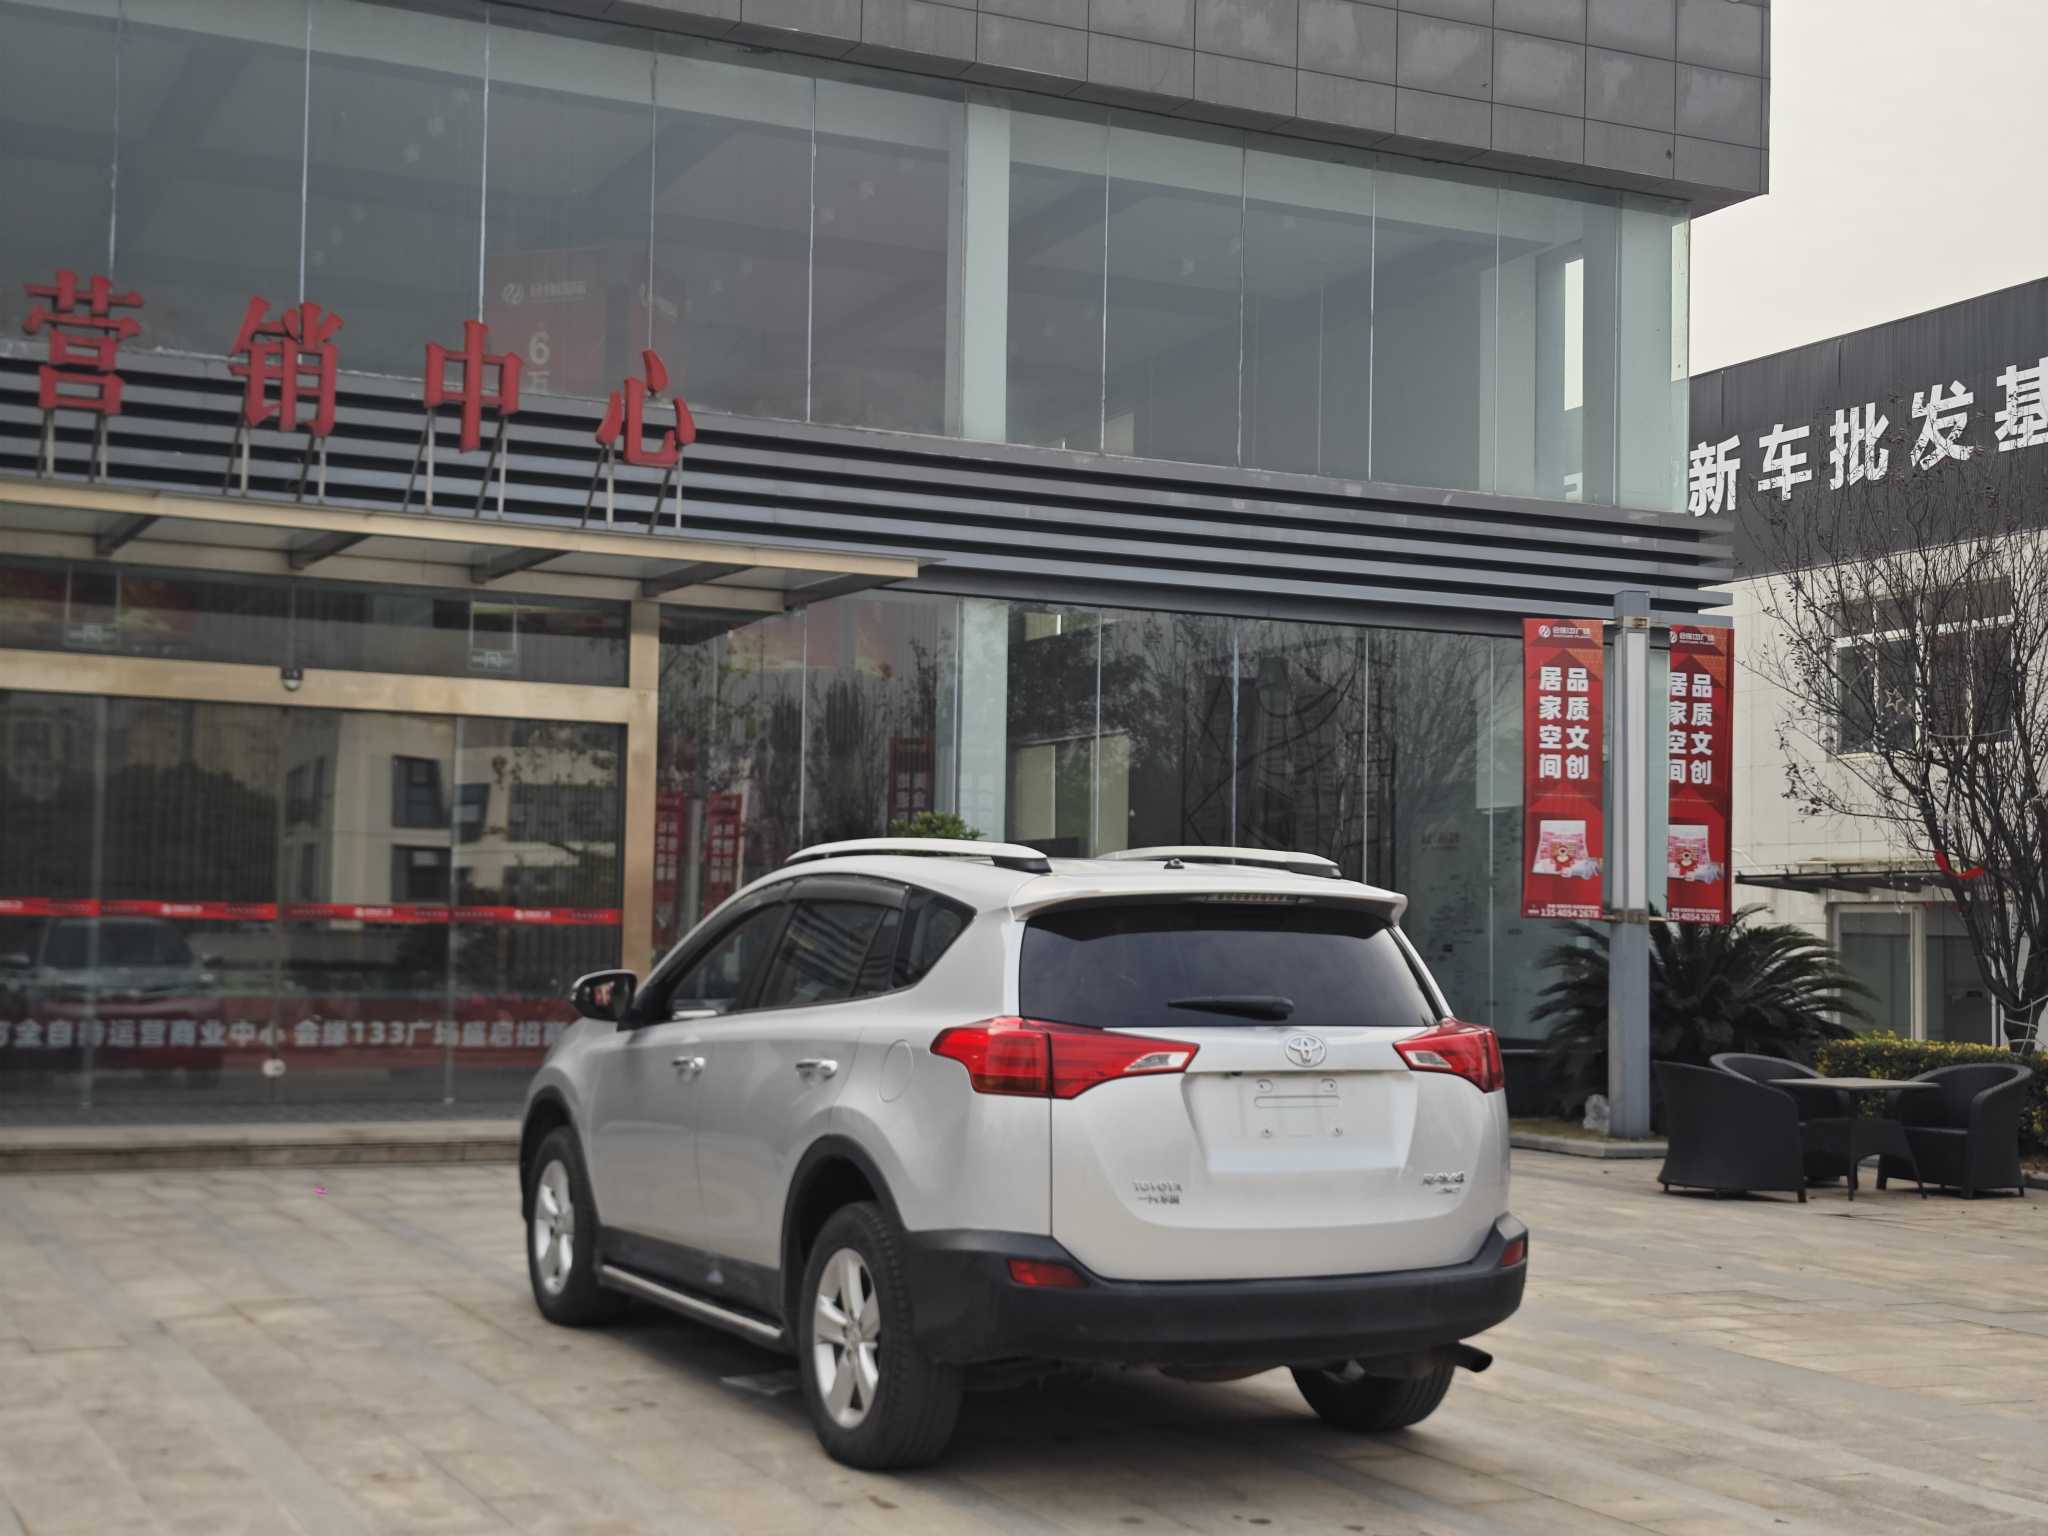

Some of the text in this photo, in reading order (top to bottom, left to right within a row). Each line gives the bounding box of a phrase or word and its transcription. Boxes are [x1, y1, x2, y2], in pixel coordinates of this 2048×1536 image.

[22, 268, 697, 466] 营销中心
[1688, 356, 2048, 517] 新车批发基
[1538, 665, 1562, 779] 居家空间
[1566, 667, 1590, 780] 品质文创
[1668, 671, 1687, 784] 居家空间
[1690, 673, 1713, 785] 品质文创
